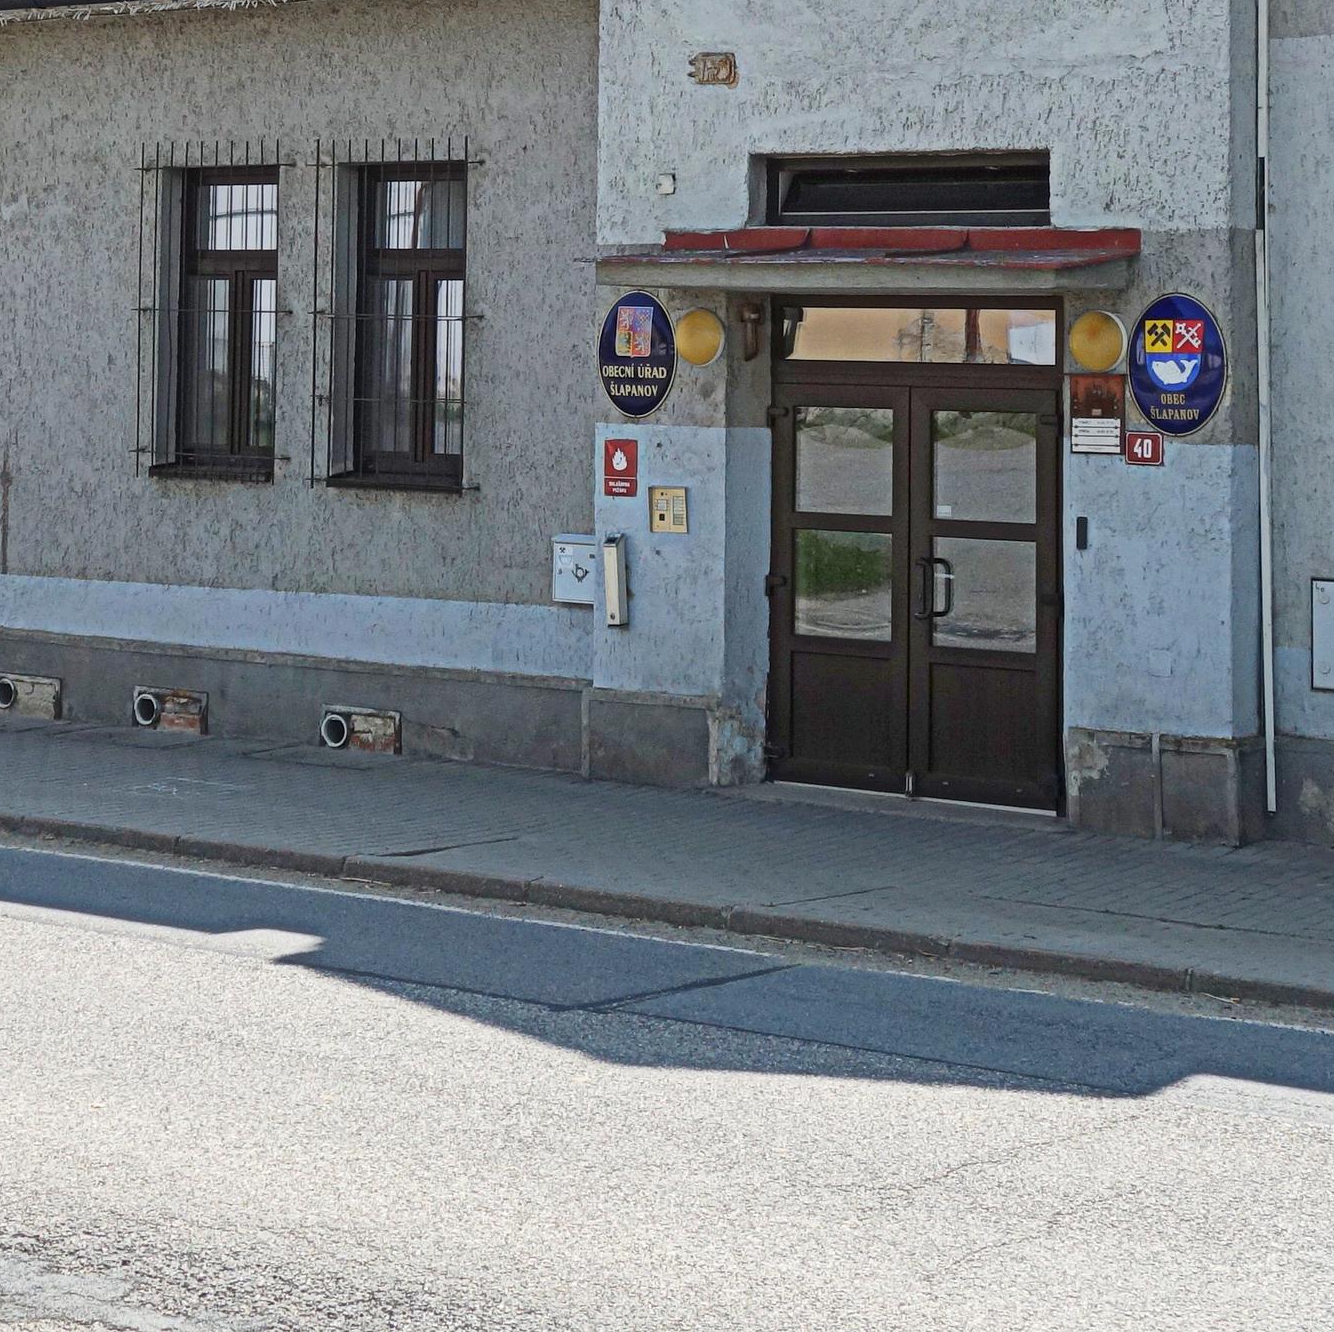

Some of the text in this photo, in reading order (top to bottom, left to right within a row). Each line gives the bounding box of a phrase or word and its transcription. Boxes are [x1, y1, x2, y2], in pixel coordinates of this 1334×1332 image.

[602, 363, 667, 379] OBECNÍ ÚŘAD
[610, 381, 658, 397] ŠLAPANOV
[1160, 393, 1186, 405] OBEC
[1150, 406, 1199, 420] ŠLAPANOV
[1133, 438, 1153, 459] 40
